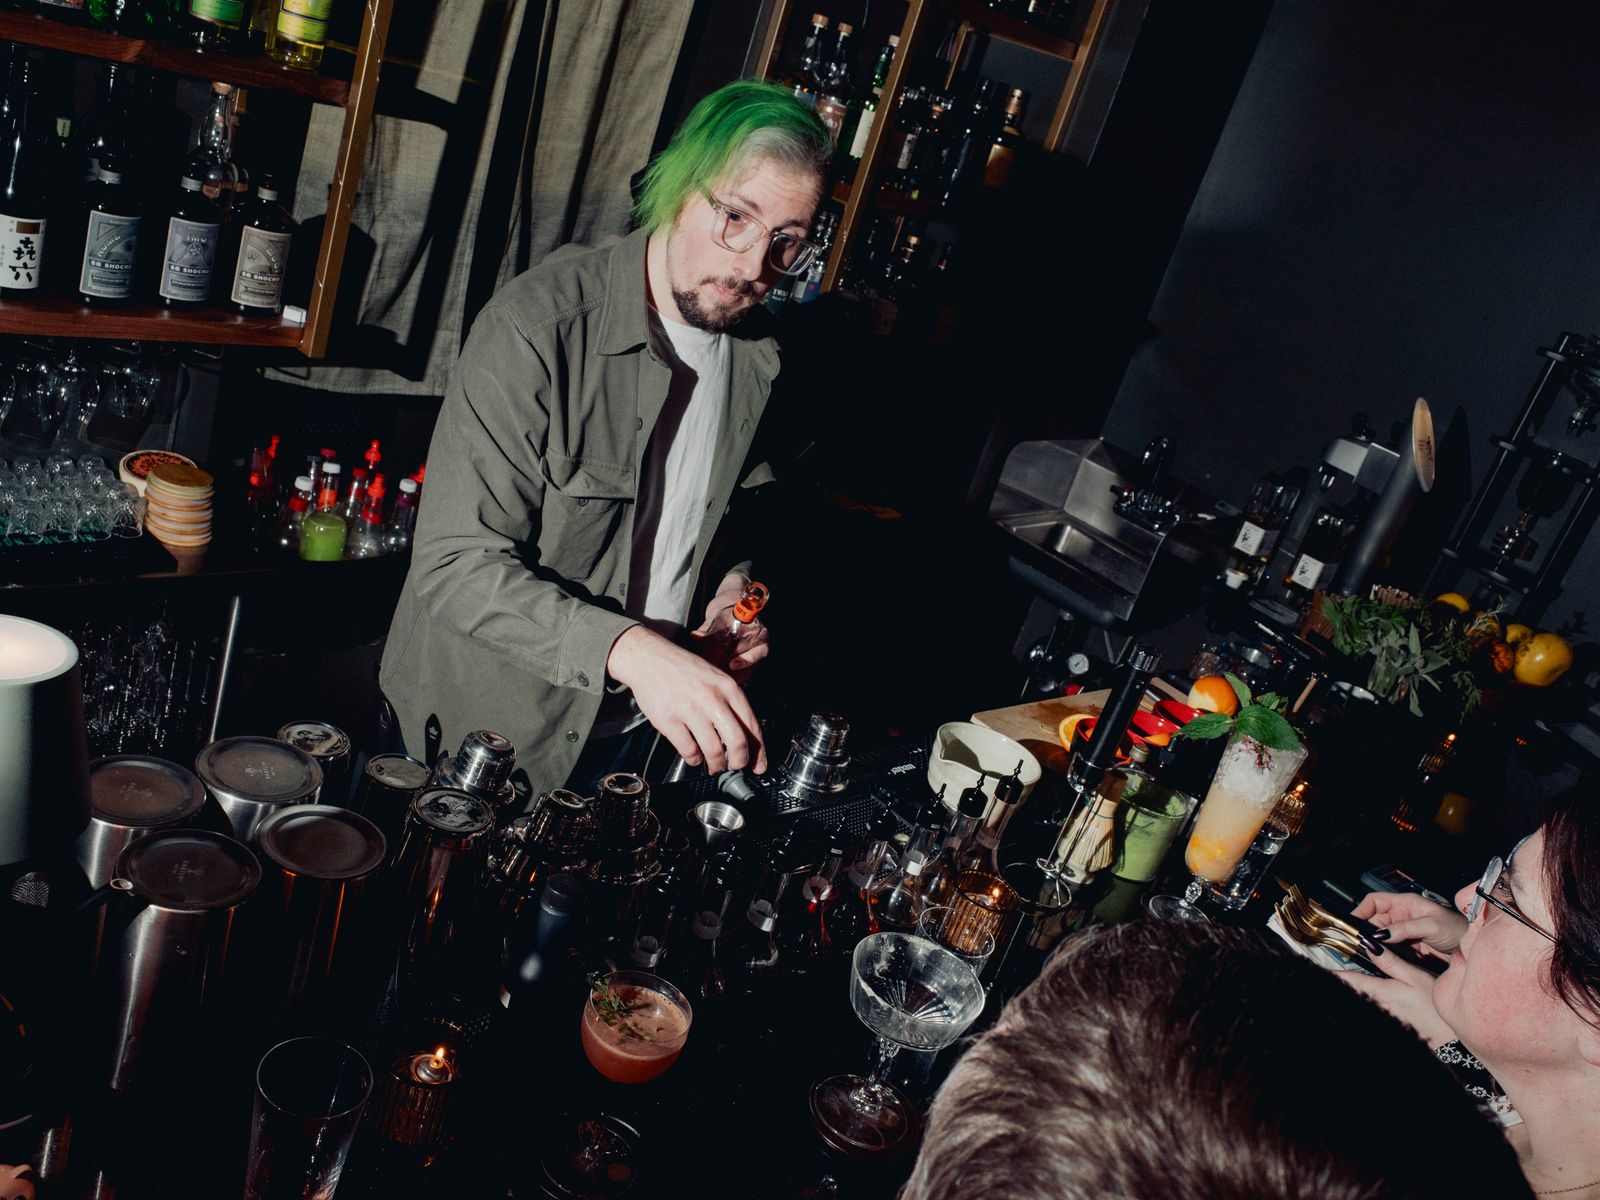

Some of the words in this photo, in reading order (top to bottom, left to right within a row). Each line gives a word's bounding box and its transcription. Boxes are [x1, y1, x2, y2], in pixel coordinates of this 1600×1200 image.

[104, 263, 133, 271] SHOCHU
[182, 266, 210, 275] SHOCHU
[253, 273, 281, 282] SHOCHU
